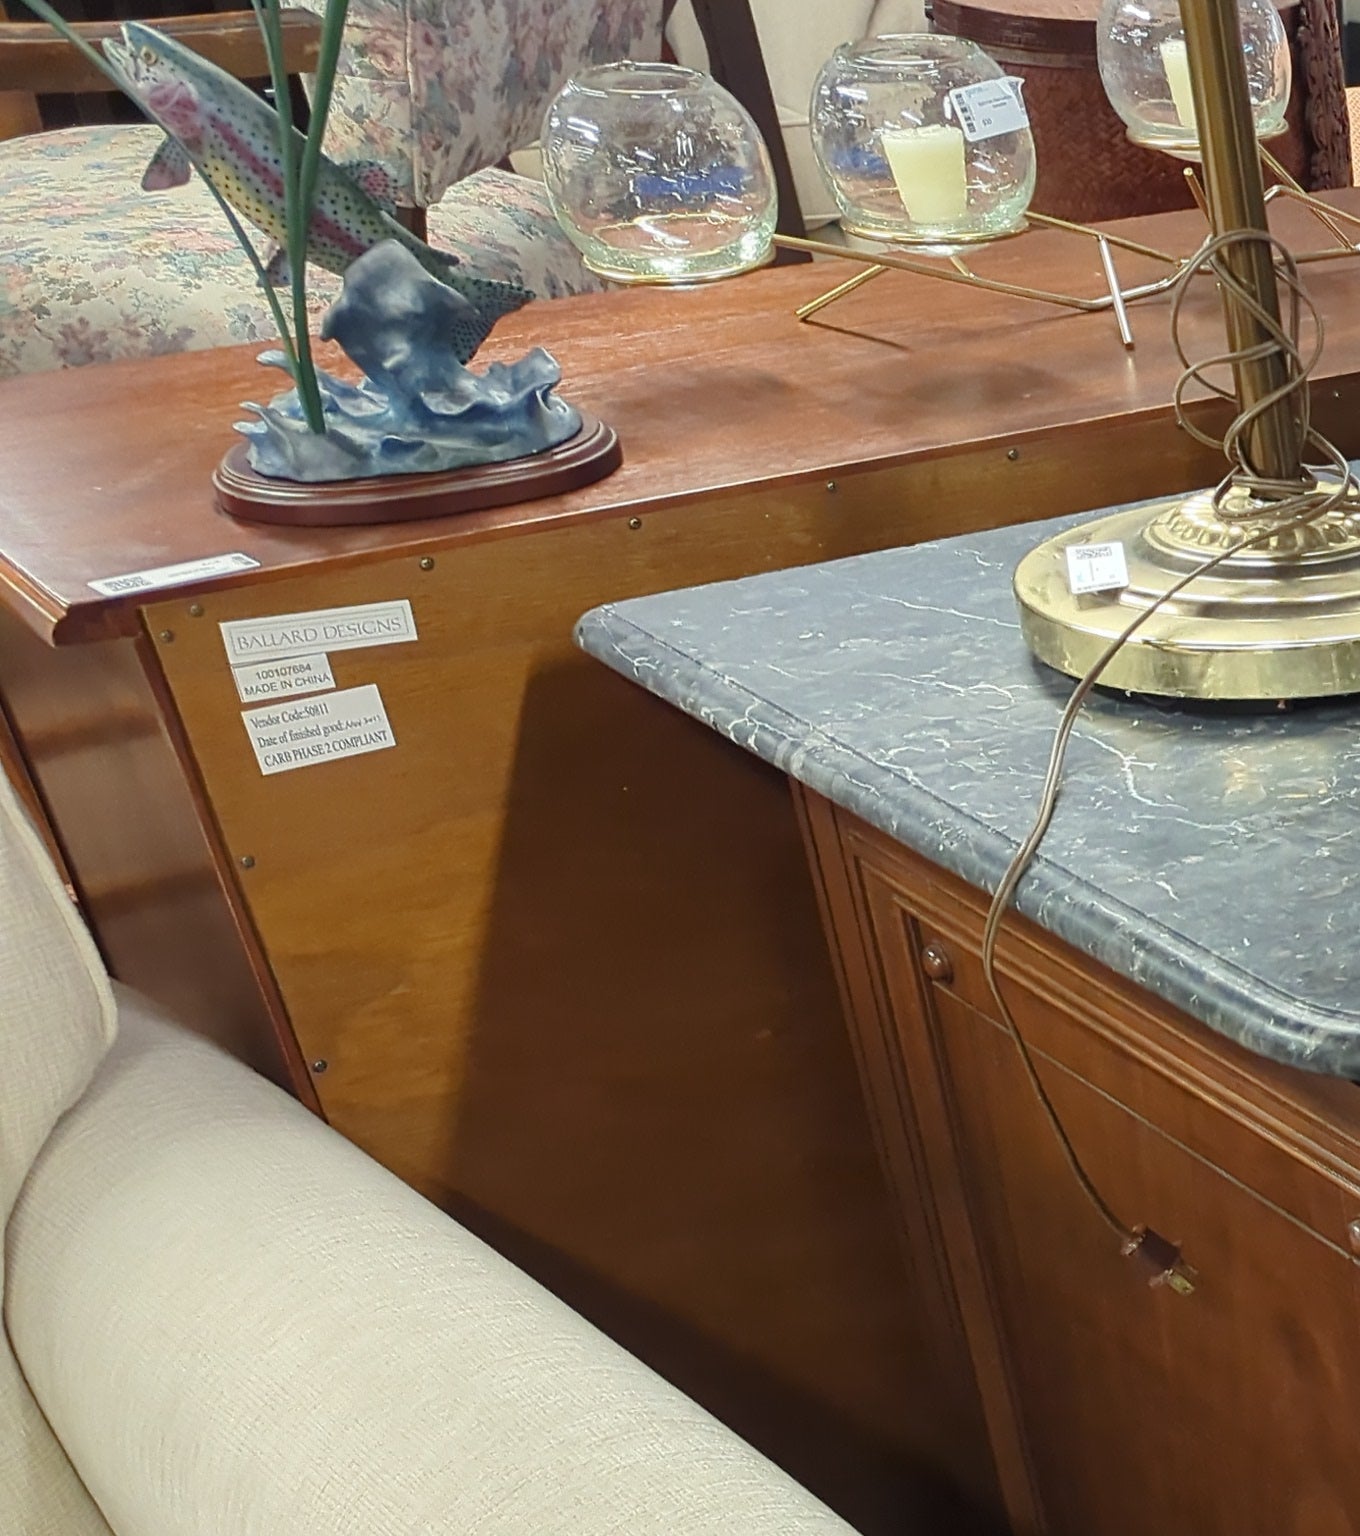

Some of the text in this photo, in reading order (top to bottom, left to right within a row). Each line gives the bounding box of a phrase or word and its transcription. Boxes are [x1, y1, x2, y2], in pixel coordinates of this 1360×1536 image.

[237, 616, 402, 650] BALLARD DESIGNS
[244, 673, 331, 696] MADE IN CHINA
[250, 713, 280, 729] Vendor
[257, 736, 279, 748] Date
[279, 731, 288, 743] of
[289, 724, 322, 742] finished
[264, 730, 387, 767] CARB PHASE 2 COMPLIANT
